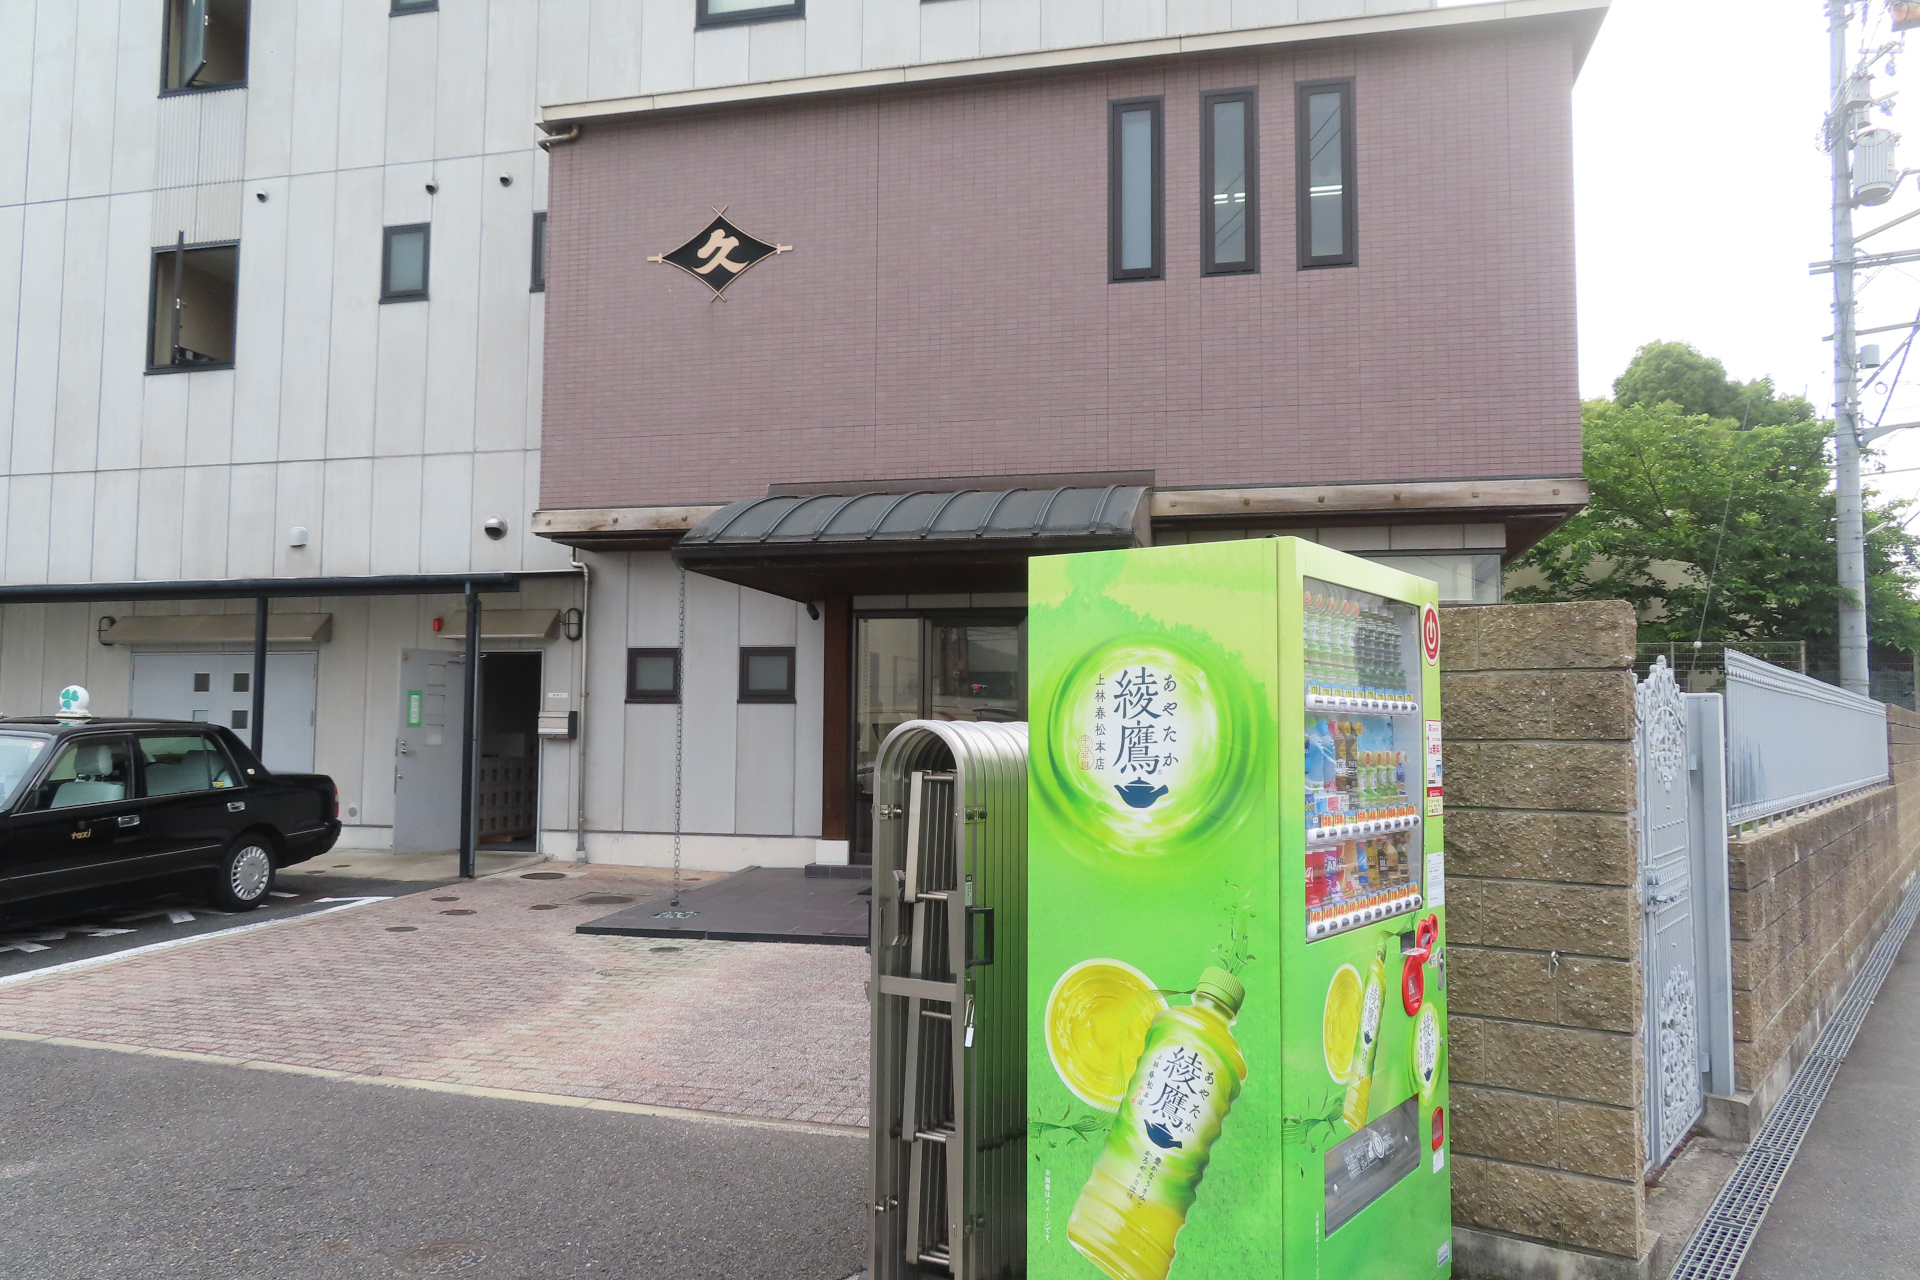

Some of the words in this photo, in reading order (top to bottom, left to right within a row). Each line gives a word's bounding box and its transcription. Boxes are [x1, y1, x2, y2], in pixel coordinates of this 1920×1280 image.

[692, 229, 749, 274] 久
[1094, 673, 1106, 770] 上林春松本店
[1112, 666, 1162, 775] 綾鷹
[1162, 674, 1179, 767] あやたか
[71, 828, 92, 840] taxi
[1148, 1046, 1202, 1128] 綾鷹
[1184, 1071, 1214, 1134] あやたか
